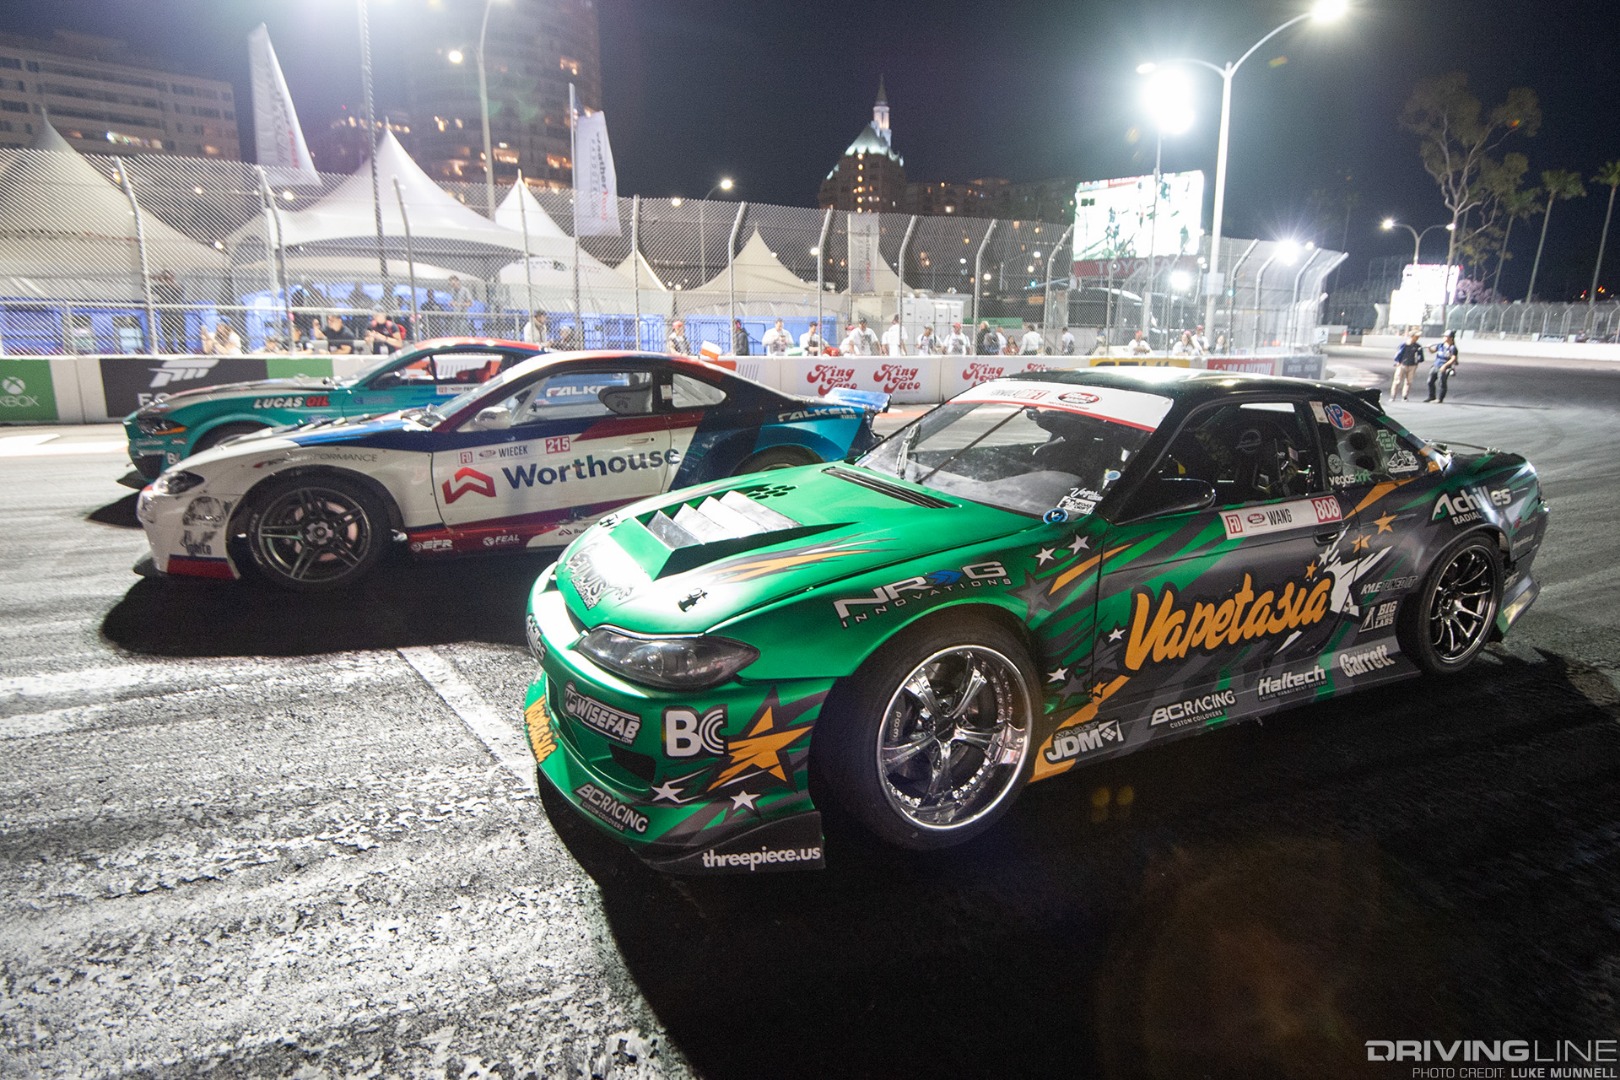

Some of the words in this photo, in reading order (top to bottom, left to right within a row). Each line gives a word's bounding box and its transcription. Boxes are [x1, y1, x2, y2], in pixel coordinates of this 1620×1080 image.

[806, 363, 856, 383] King
[873, 363, 919, 382] King
[962, 362, 1004, 381] King
[883, 377, 921, 394] Taco
[253, 396, 304, 409] LUCAS
[305, 395, 330, 407] OIL
[777, 407, 856, 422] FALKEN
[498, 444, 529, 458] WIECEK
[547, 437, 570, 452] 215
[501, 447, 681, 490] Worthouse
[1266, 508, 1293, 526] WANG
[1314, 497, 1339, 520] 808
[1430, 485, 1512, 521] Achilles
[1452, 511, 1483, 526] RADIAL
[832, 561, 1008, 619] NRG
[842, 577, 1012, 629] INNOVATIONS
[1377, 600, 1398, 616] BIG
[1124, 572, 1332, 671] Vapetasia
[1374, 619, 1394, 629] LABS
[1339, 644, 1396, 678] Garrett
[1258, 664, 1326, 696] Haltech
[576, 697, 640, 740] WISEFAB
[1169, 718, 1192, 729] CUSTOM
[1192, 710, 1223, 723] COILOVERS
[664, 709, 725, 758] BC
[1046, 728, 1104, 761] JDM
[702, 845, 821, 871] threepiece.us
